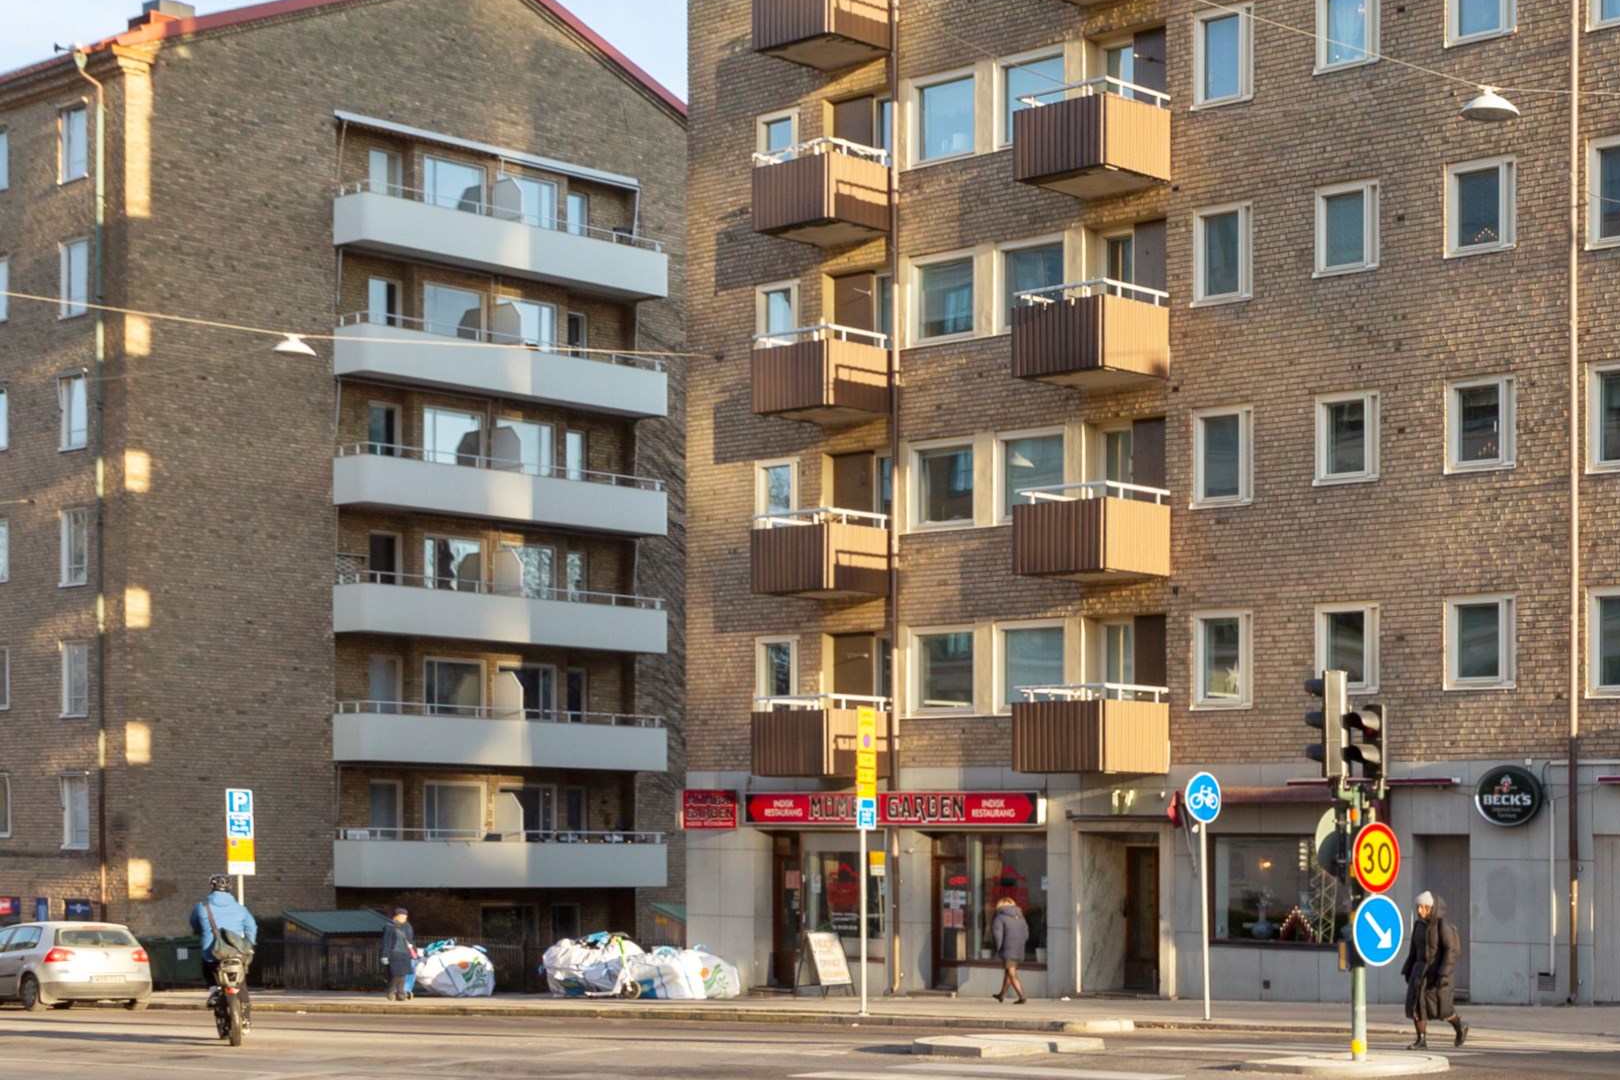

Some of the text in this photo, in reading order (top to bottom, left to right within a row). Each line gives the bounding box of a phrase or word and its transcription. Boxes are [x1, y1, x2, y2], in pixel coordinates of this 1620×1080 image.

[233, 792, 248, 813] P
[773, 799, 794, 808] INDISK
[981, 799, 1006, 808] INDISK
[1482, 792, 1532, 806] BECK'S
[686, 806, 734, 820] GARDEN
[764, 808, 803, 818] RESTAURANG
[887, 795, 966, 823] GARDEN
[971, 808, 1016, 818] RESTAURANG
[1363, 842, 1392, 875] 30
